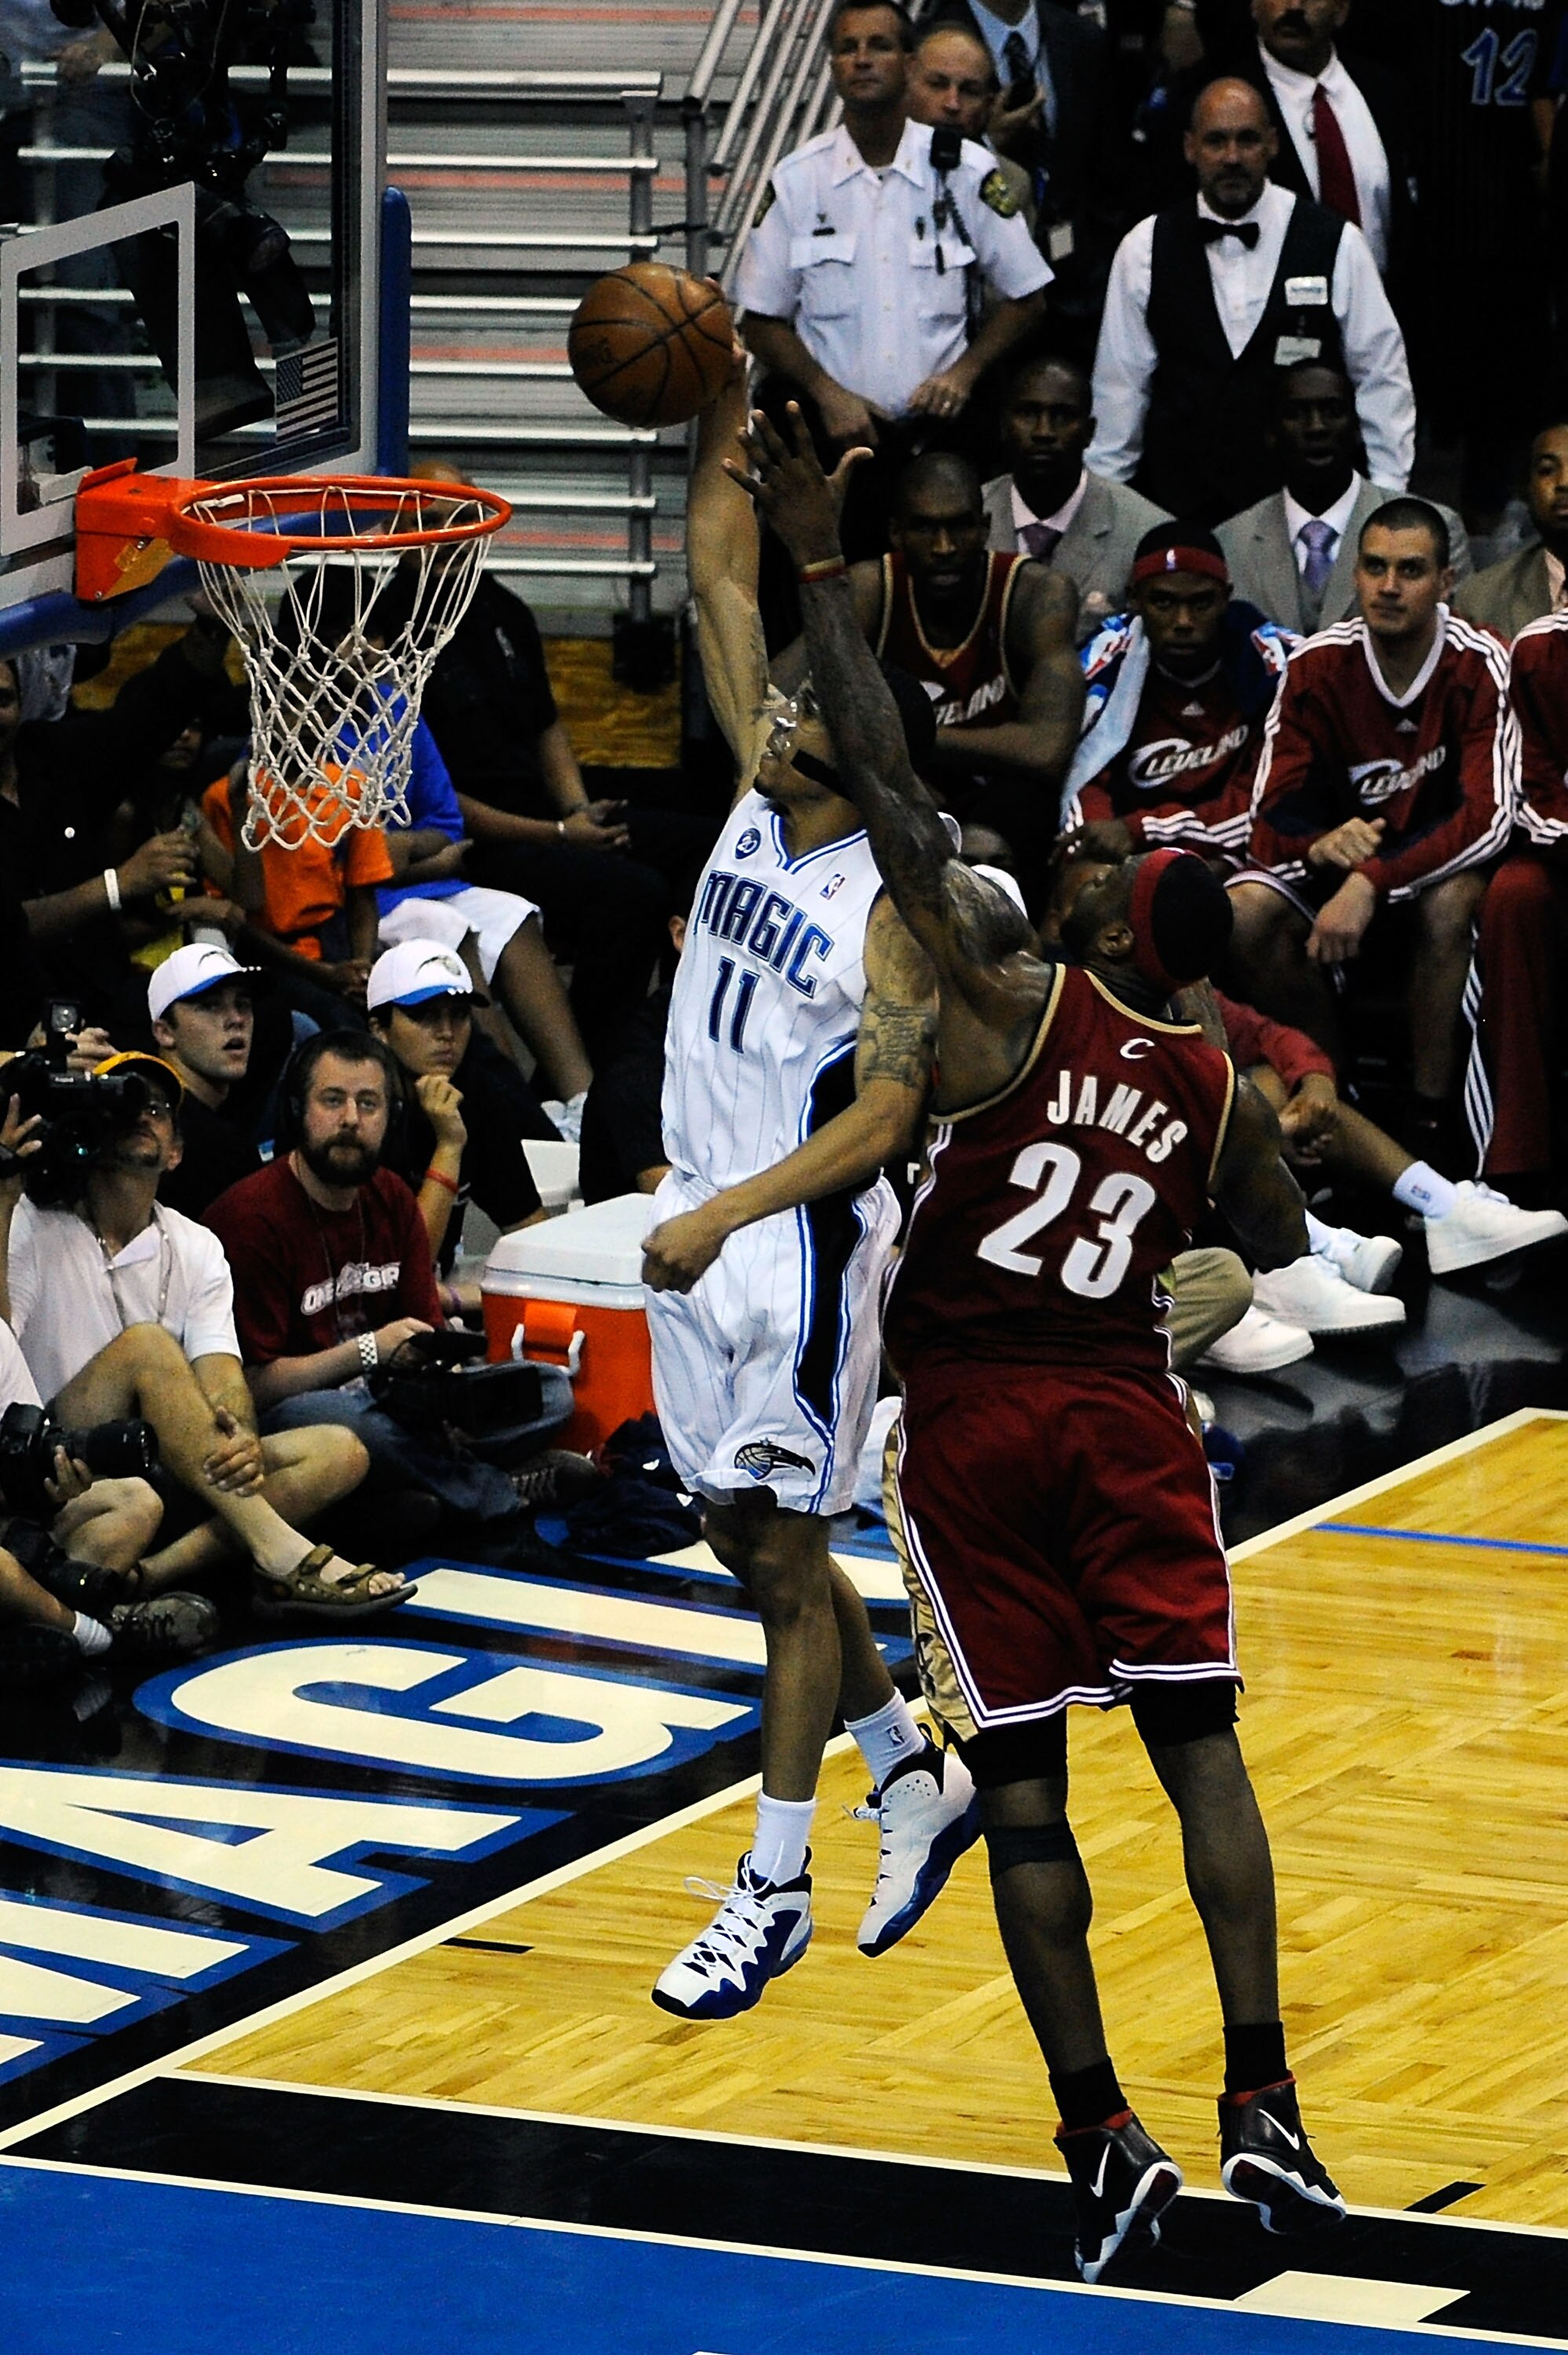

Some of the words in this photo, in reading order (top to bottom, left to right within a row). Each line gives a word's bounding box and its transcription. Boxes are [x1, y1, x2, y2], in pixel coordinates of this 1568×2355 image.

[1460, 27, 1538, 106] 12
[1128, 724, 1249, 789] CLEVELAND
[694, 869, 835, 999] MAGIC
[708, 955, 760, 1054] 11
[1119, 1037, 1155, 1060] C
[1046, 1069, 1188, 1163] JAMES
[977, 1141, 1157, 1299] 23
